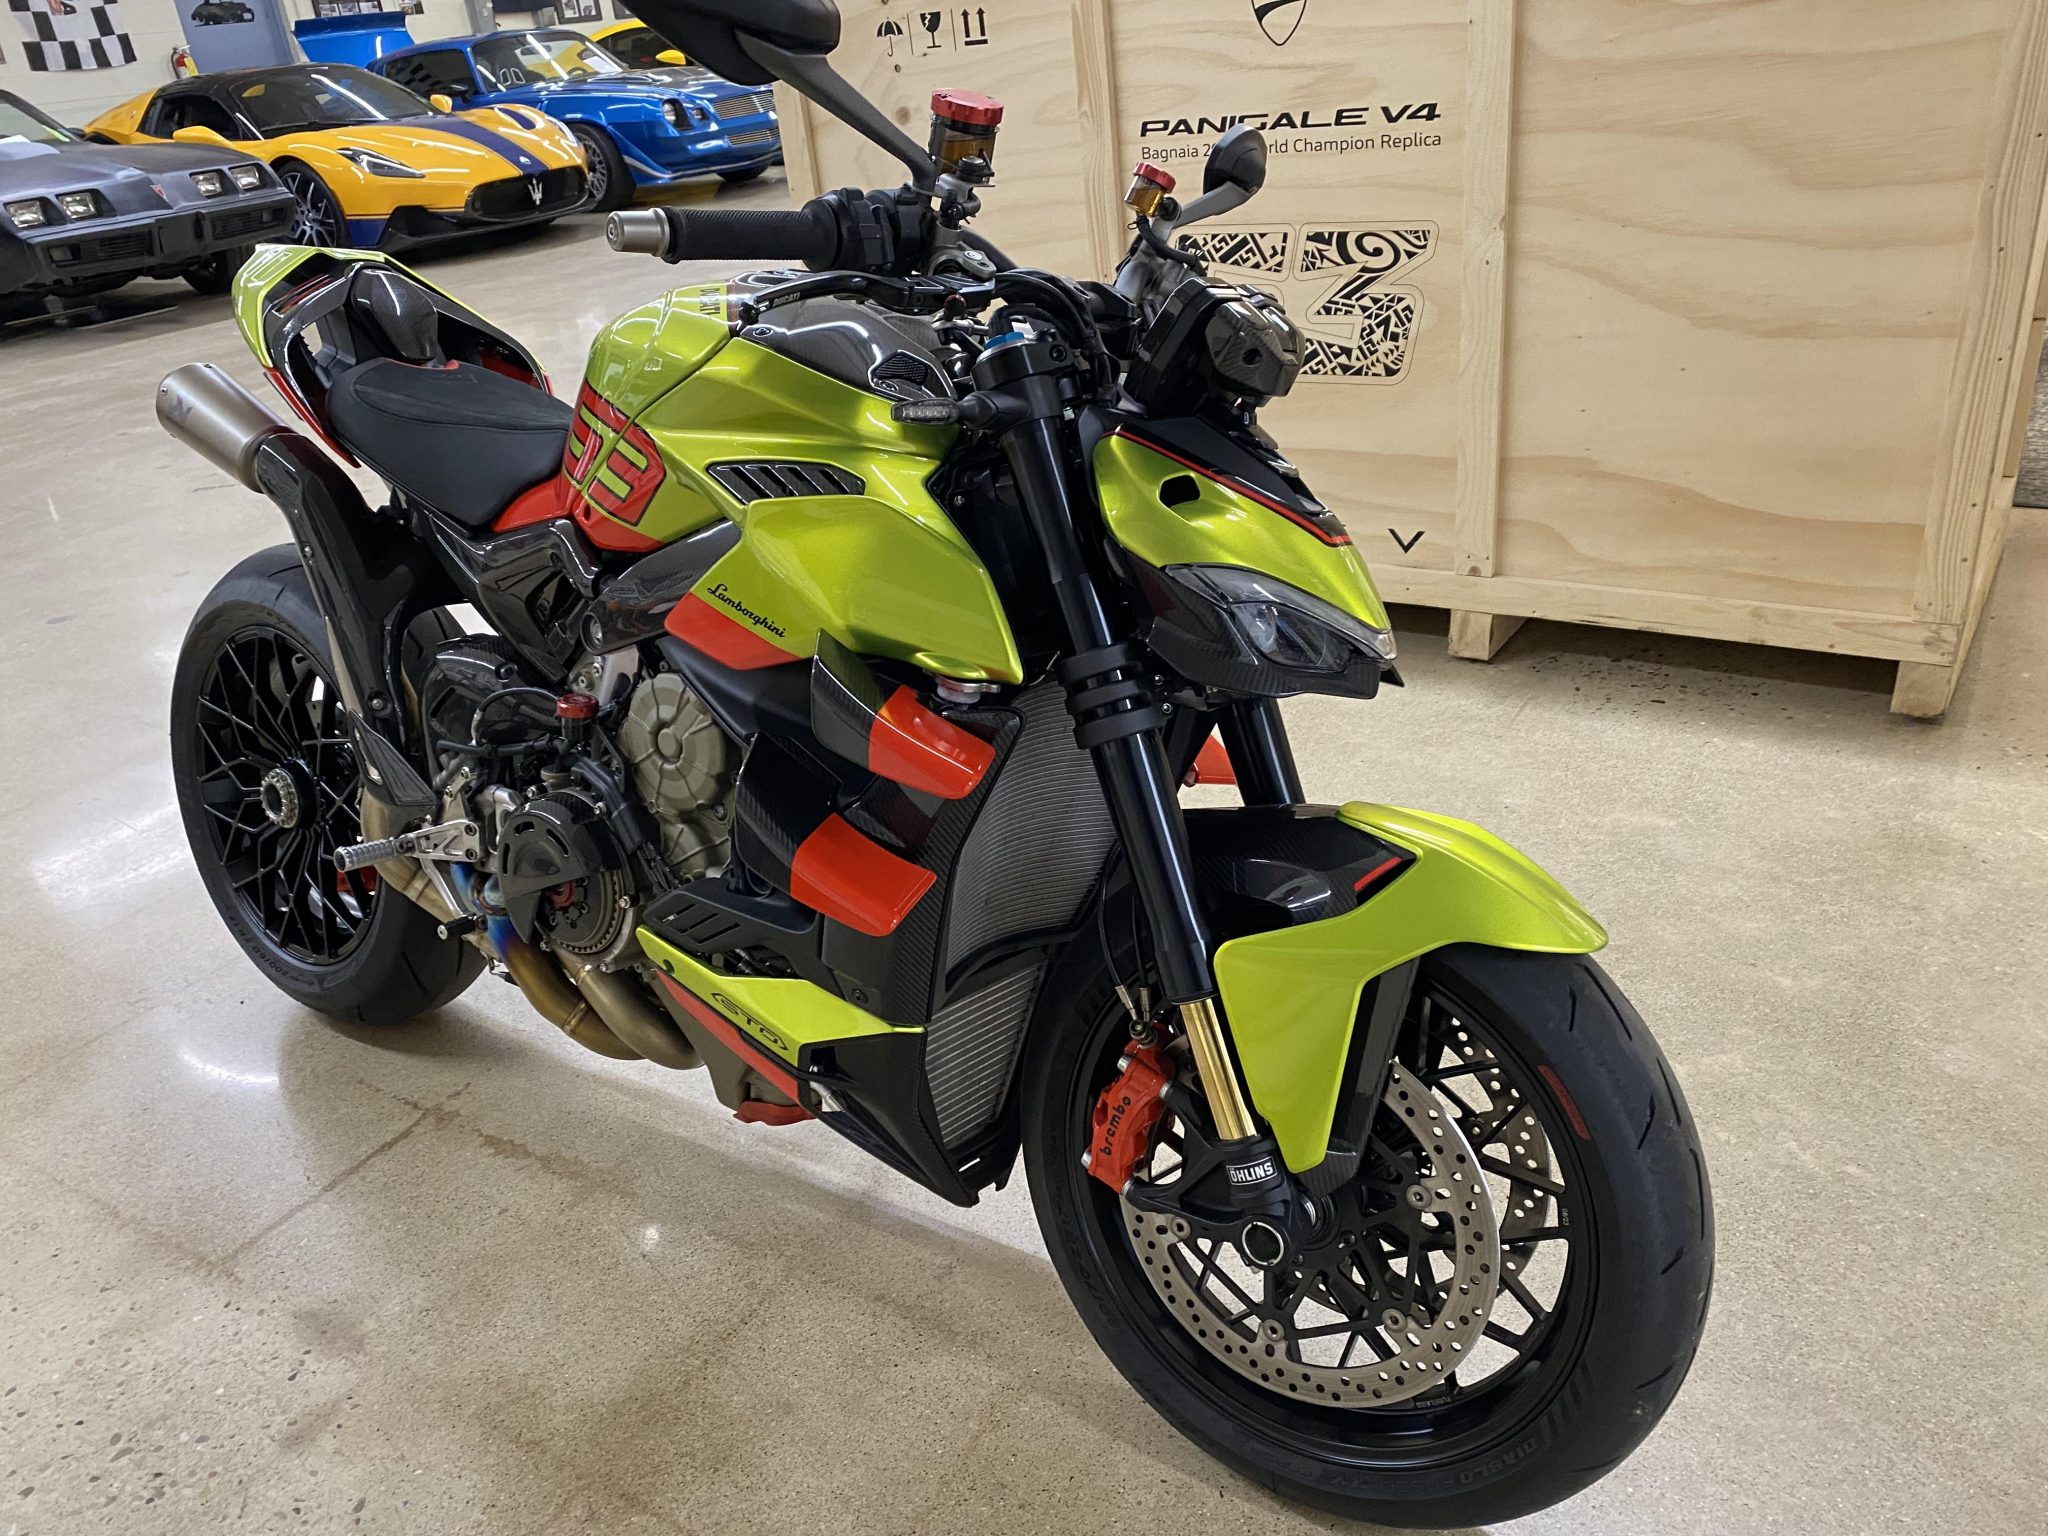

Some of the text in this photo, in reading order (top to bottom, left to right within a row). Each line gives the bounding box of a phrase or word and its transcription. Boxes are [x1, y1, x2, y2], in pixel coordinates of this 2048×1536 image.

[1140, 102, 1441, 137] PANIGALE V4
[1141, 144, 1199, 163] Bagnaia
[1267, 138, 1289, 155] rld
[1293, 136, 1375, 154] Champion
[1380, 132, 1442, 151] Replica
[773, 291, 801, 308] DUCATI
[706, 583, 786, 638] Lamborghini
[720, 997, 779, 1045] STO
[1099, 1095, 1131, 1156] brembo
